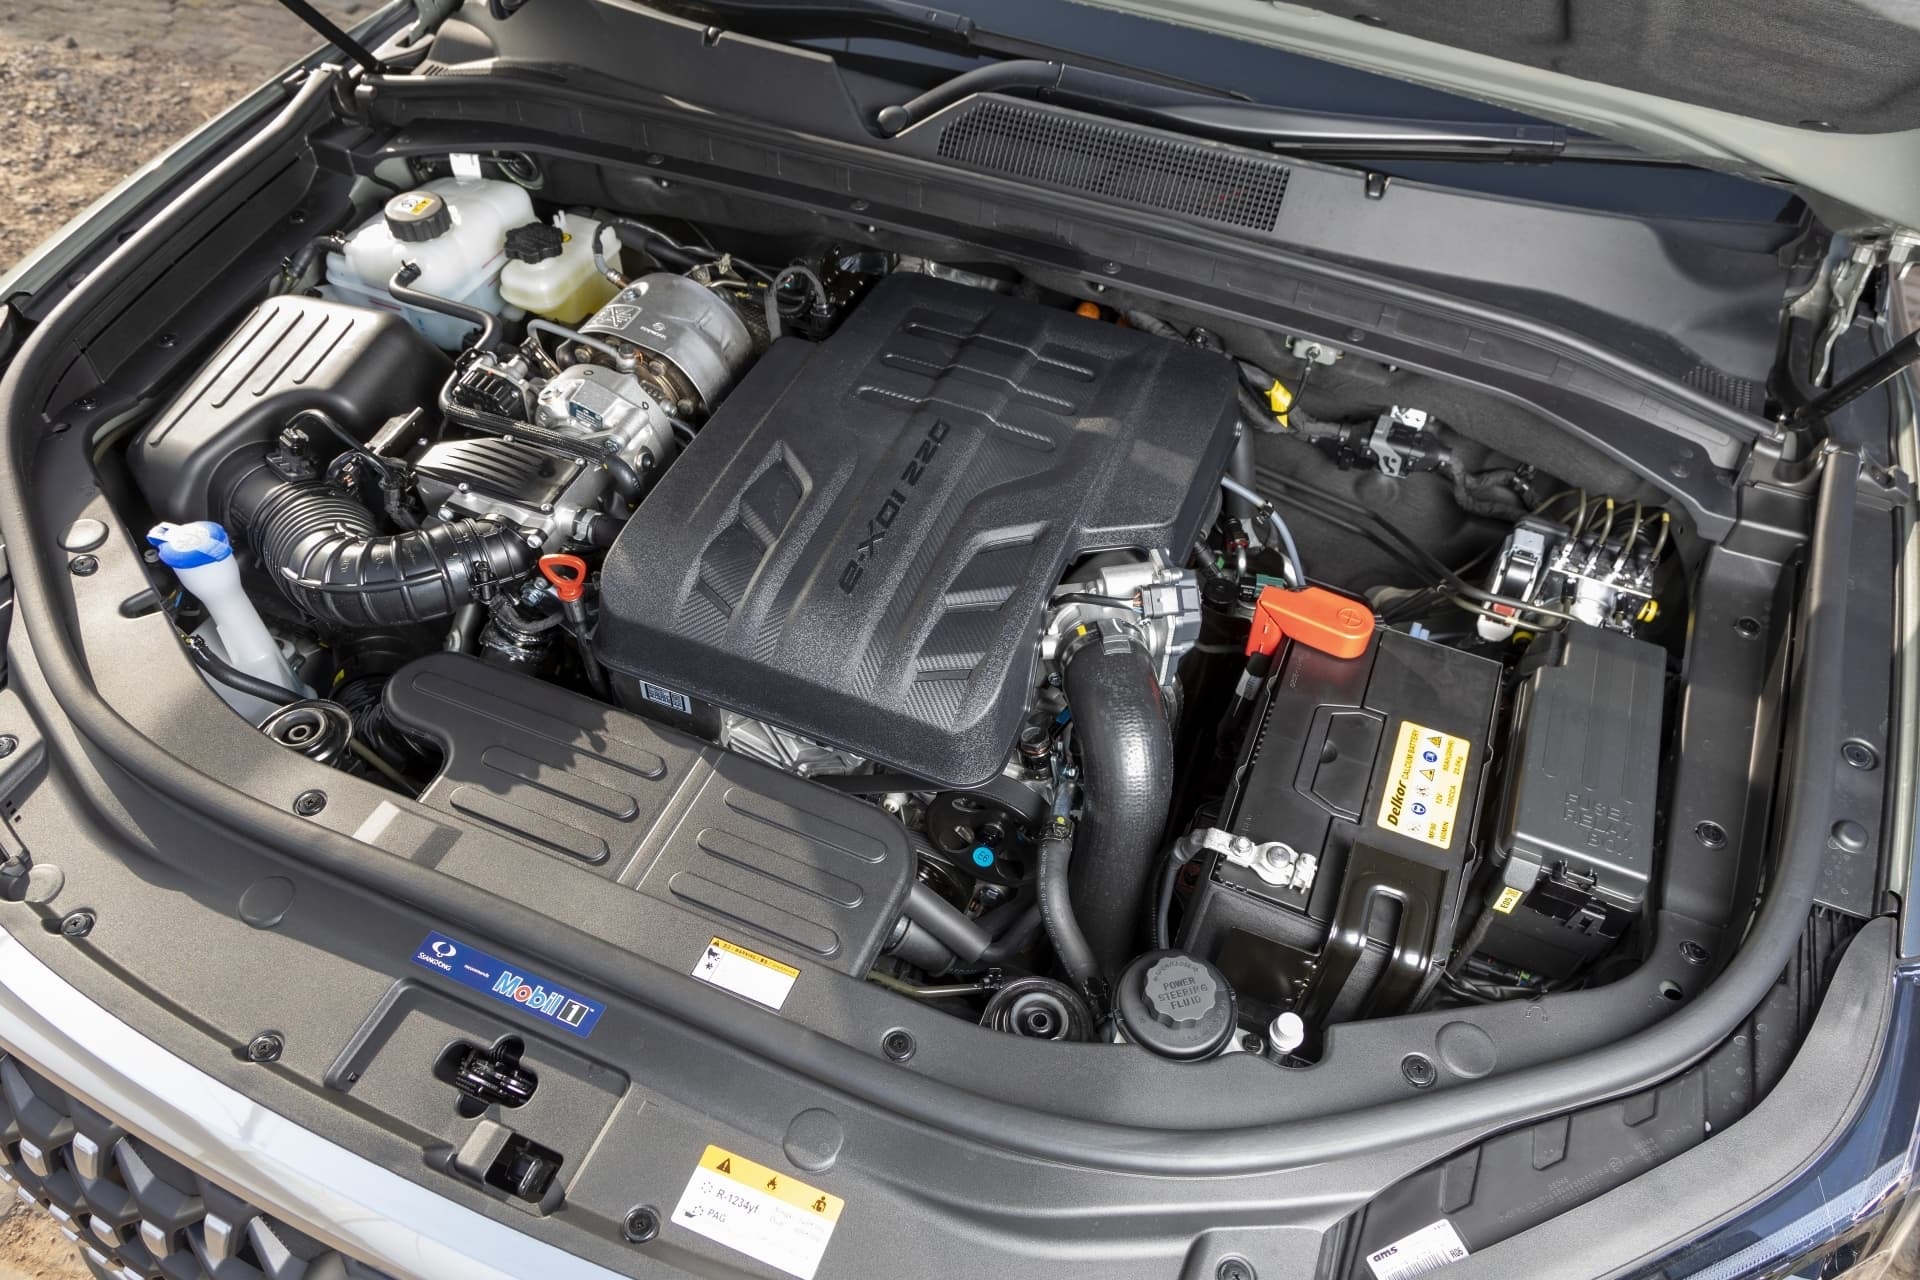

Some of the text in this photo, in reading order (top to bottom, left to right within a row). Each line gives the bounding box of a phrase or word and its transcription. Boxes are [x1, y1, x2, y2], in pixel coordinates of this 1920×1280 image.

[901, 418, 951, 487] 220
[1387, 780, 1407, 826] Delkor
[1408, 729, 1419, 753] BATTERY
[1158, 983, 1208, 1002] STEERING
[1163, 976, 1196, 991] POWER
[492, 970, 565, 1017] Mobil
[1170, 995, 1201, 1010] FLUID
[716, 1188, 760, 1215] R-1234yf
[707, 1208, 728, 1224] PAG
[1373, 1246, 1398, 1262] ams
